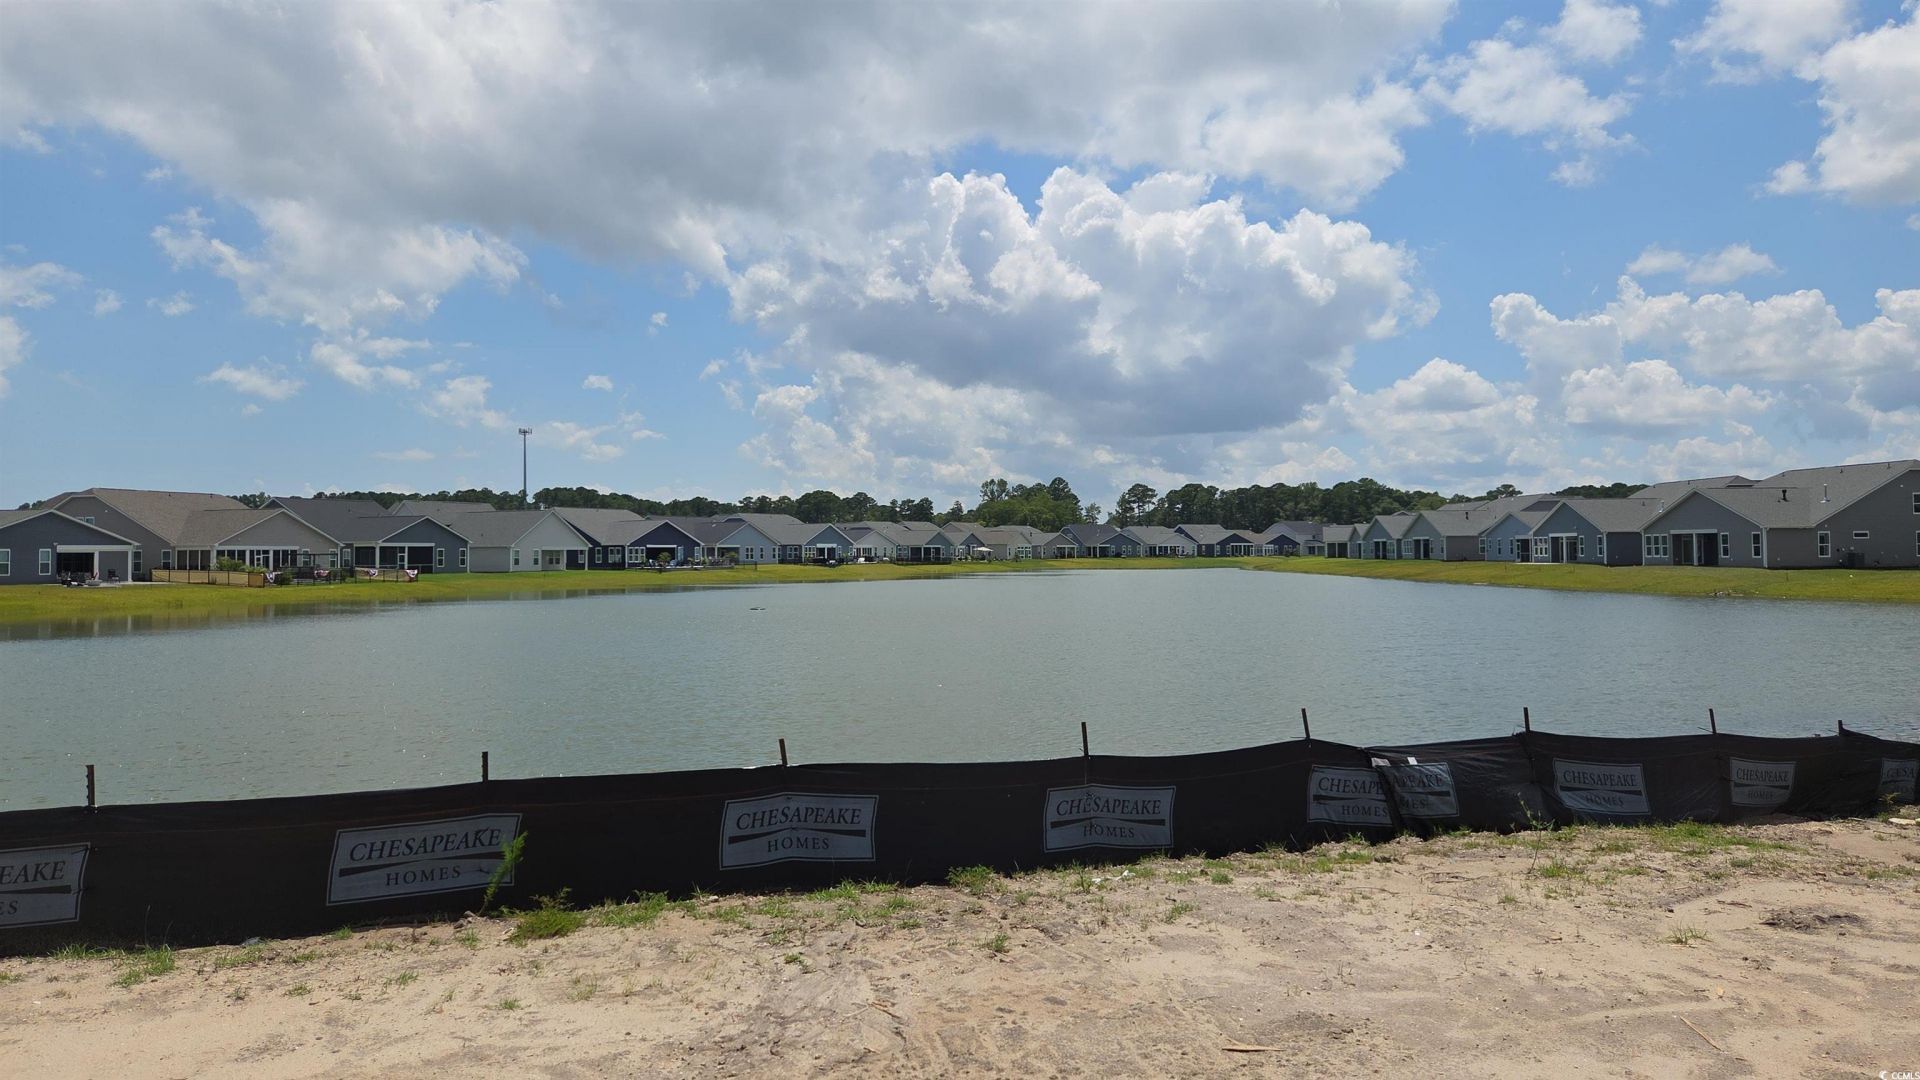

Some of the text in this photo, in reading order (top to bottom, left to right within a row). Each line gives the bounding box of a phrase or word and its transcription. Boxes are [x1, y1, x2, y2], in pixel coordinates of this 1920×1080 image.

[1563, 769, 1637, 787] CHESAPEAKE
[1736, 768, 1788, 782] CHESAPEAKE
[1056, 797, 1161, 816] CHESAPEAKE
[1585, 794, 1625, 807] HOMES
[736, 806, 862, 830] CHESAPEAKE
[1342, 805, 1388, 817] HOMES
[1083, 822, 1135, 838] HOMES
[350, 827, 502, 862] CHESAPEAKE
[768, 836, 830, 852] HOMES
[386, 865, 461, 886] HOMES
